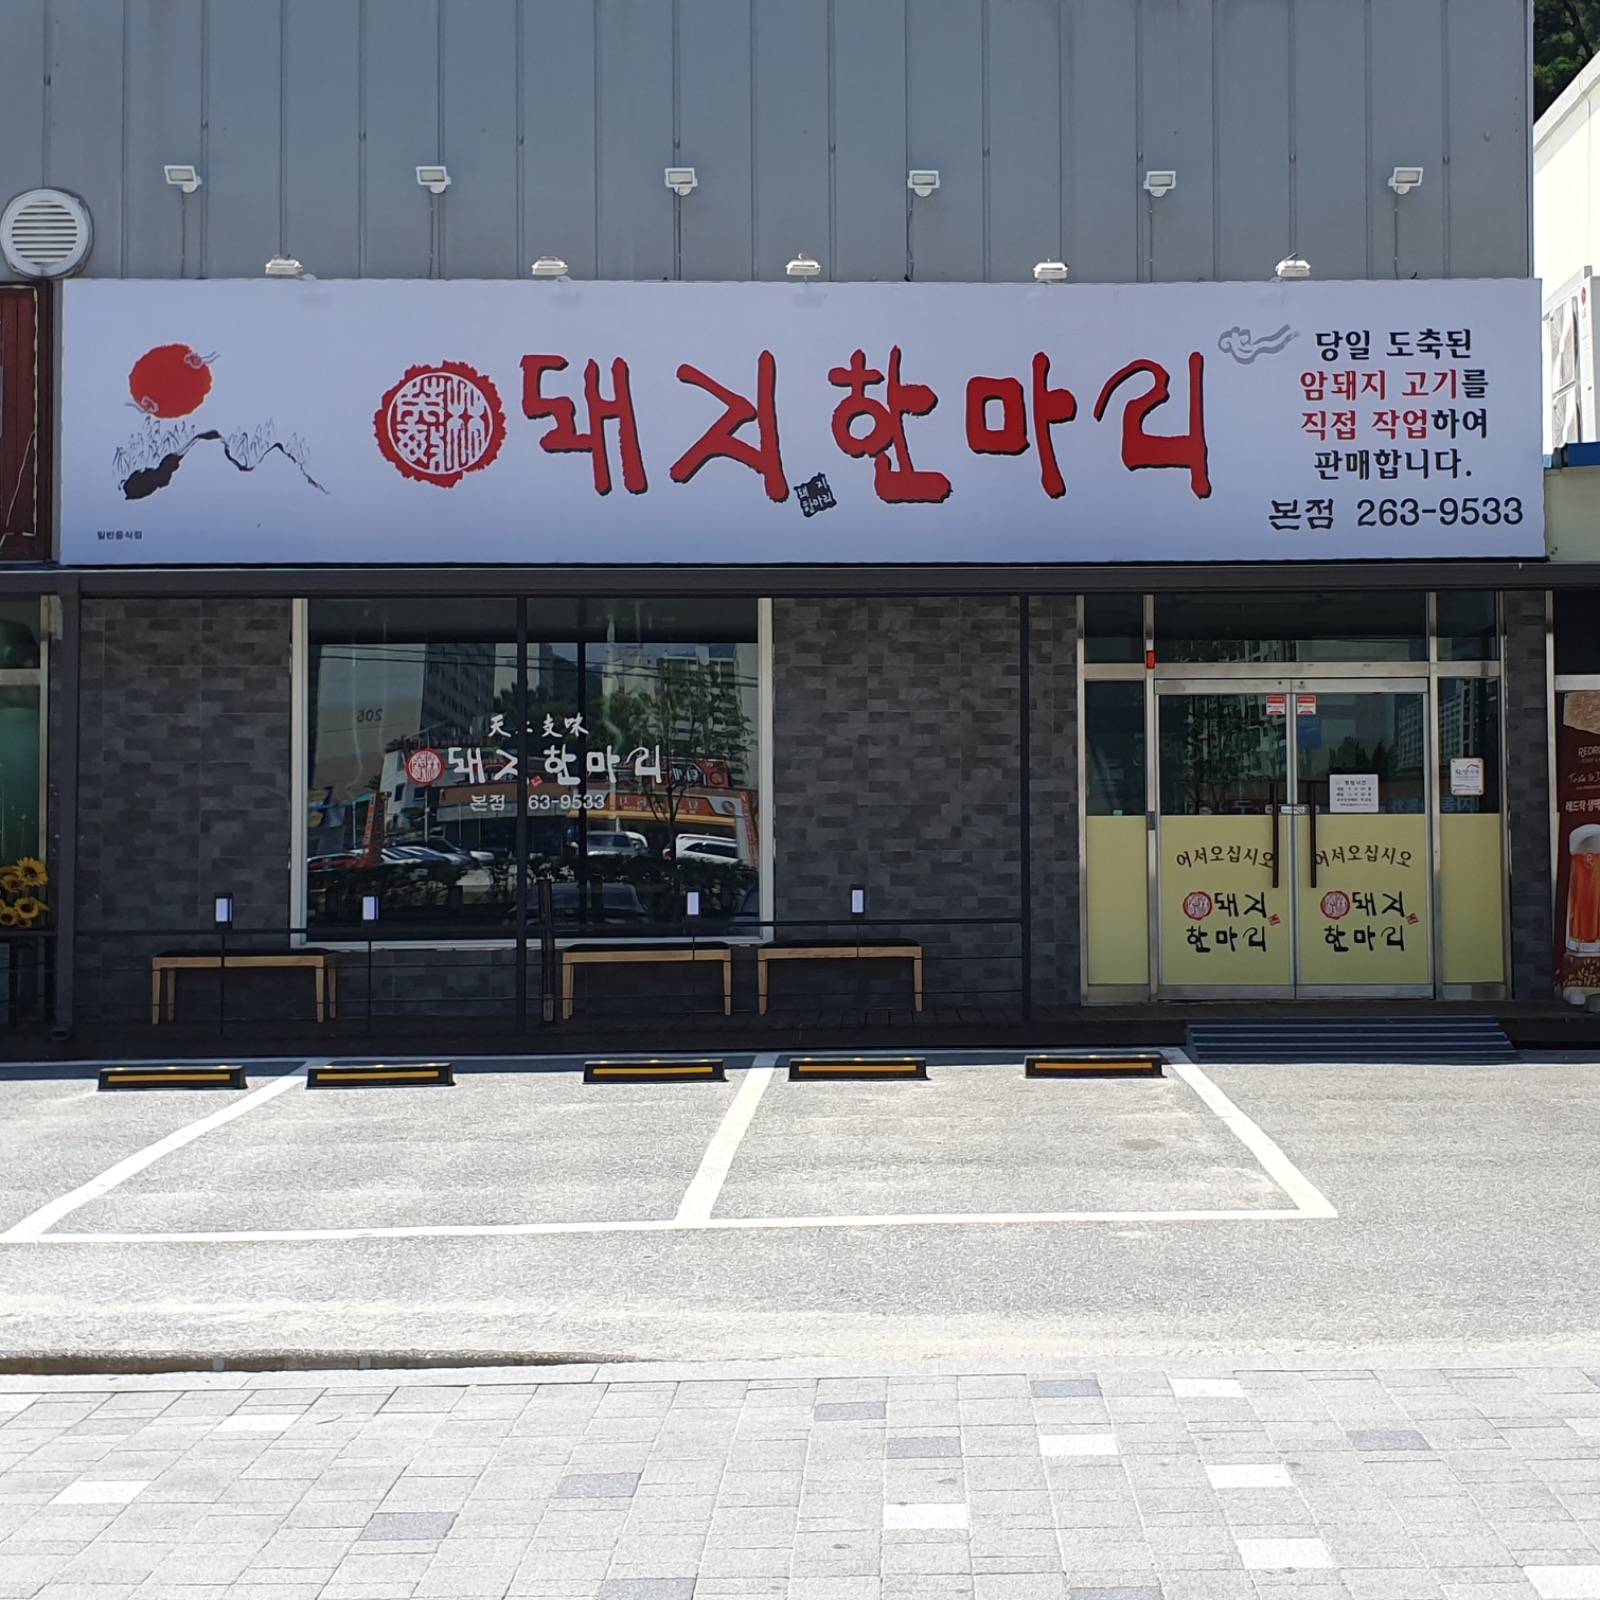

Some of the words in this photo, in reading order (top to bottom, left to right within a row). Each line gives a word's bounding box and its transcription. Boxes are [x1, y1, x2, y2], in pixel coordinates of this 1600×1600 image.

[1315, 330, 1371, 362] 당일
[1386, 328, 1472, 360] 도축된
[1300, 370, 1386, 401] 암돼지
[1401, 369, 1489, 400] 고기를
[1301, 409, 1357, 441] 직접
[1371, 408, 1487, 440] 작업하여
[1314, 448, 1472, 480] 판매합니다.
[1268, 498, 1334, 531] 본점
[1357, 496, 1524, 527] 263-9533
[97, 530, 143, 540] 일반음식점
[470, 794, 506, 812] 본점
[1176, 845, 1274, 869] 어서오십시오
[1316, 844, 1412, 868] 어서오십시오
[1214, 891, 1267, 918] 돼지
[1352, 891, 1406, 918] 돼지
[1186, 925, 1267, 953] 한마리
[1324, 924, 1405, 953] 한마리
